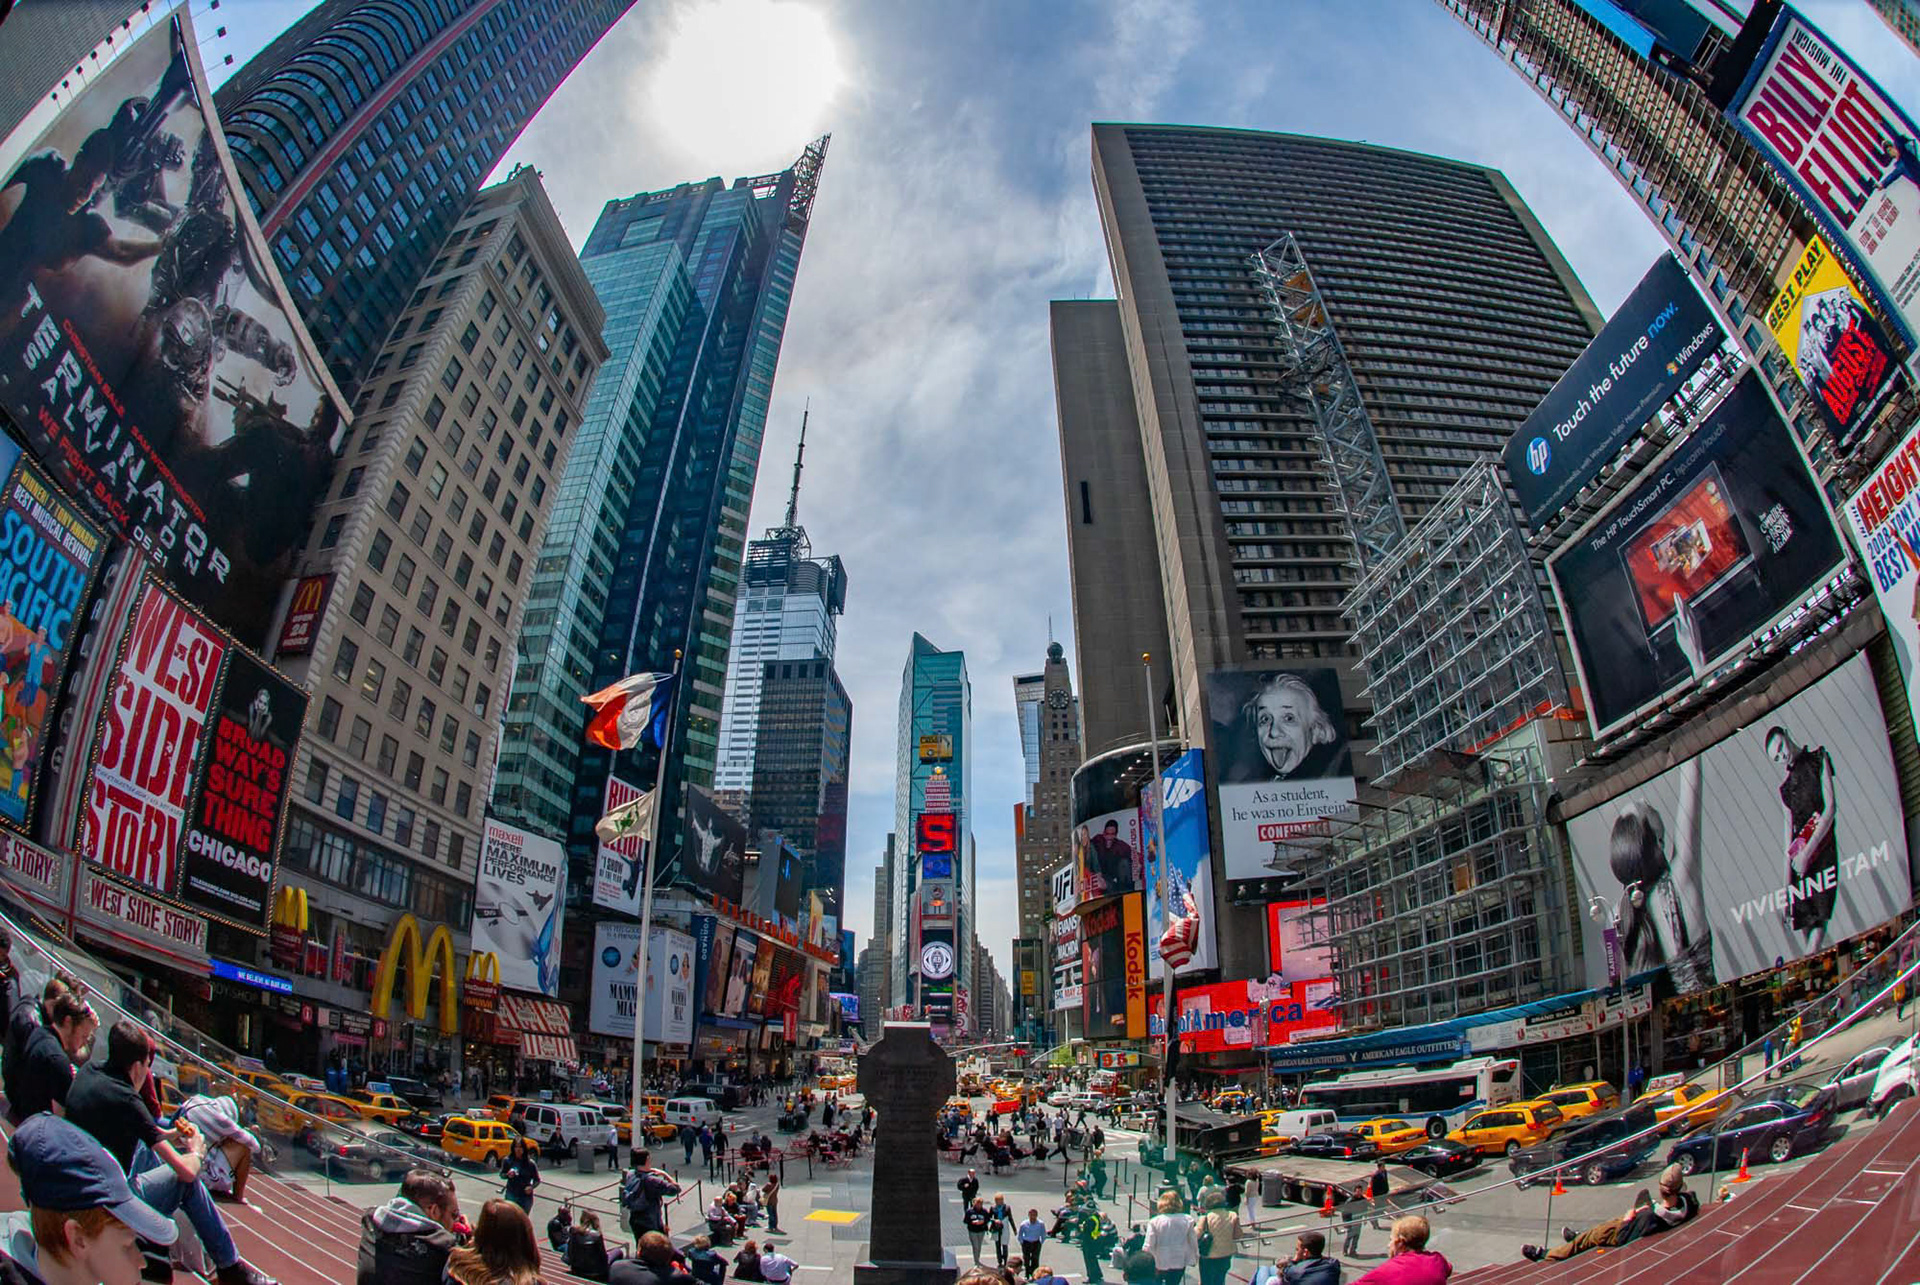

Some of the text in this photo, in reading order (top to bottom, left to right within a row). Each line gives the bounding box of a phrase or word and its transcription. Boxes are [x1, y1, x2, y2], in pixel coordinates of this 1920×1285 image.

[1793, 27, 1848, 86] THE MUSICAL
[1746, 40, 1837, 166] BILLY
[1797, 79, 1897, 231] ELLIOT
[1769, 241, 1822, 331] BEST PLAY
[1553, 301, 1679, 442] Touch the future now.
[1675, 323, 1714, 367] Windows
[21, 282, 231, 584] TERMINATOR
[23, 339, 200, 577] SALVATION
[38, 405, 60, 439] WE
[58, 436, 95, 482] FIGHT
[94, 479, 130, 527] BACK
[1591, 423, 1727, 551] The HP TouchSmart PC. hp.com/touch
[1856, 436, 1920, 537] HEIGHT
[13, 483, 35, 512] BEST
[31, 502, 65, 543] MUSICAL
[62, 532, 93, 568] REVIVAL
[1867, 526, 1892, 561] 2008
[1891, 501, 1916, 531] TONY
[0, 509, 87, 614] SOUTH
[1874, 541, 1910, 594] BEST
[0, 555, 72, 652] ACIFIC
[122, 583, 224, 716] WEST
[101, 672, 202, 809] SIDE
[216, 736, 281, 791] WAY'S
[219, 714, 286, 768] BROAD
[208, 763, 278, 820] SURE
[1232, 807, 1248, 821] he
[1250, 808, 1275, 820] was
[1278, 807, 1294, 818] no
[1253, 787, 1329, 804] As a student,
[83, 775, 180, 895] STORY
[203, 790, 272, 853] THING
[488, 836, 523, 853] WHERE
[489, 826, 524, 846] maxell
[13, 839, 54, 885] STORY
[188, 829, 272, 883] CHICAGO
[483, 862, 526, 886] LIVES
[484, 855, 556, 884] PERFORMANCE
[486, 844, 557, 877] MAXIMUM
[1730, 840, 1891, 925] VIVIENNE TAM
[91, 877, 127, 917] WEST
[127, 895, 162, 932] SIDE
[163, 910, 202, 945] STORY
[701, 917, 710, 961] VORNADO
[1058, 915, 1077, 937] EVANS
[1126, 931, 1144, 1000] Kodak
[1606, 942, 1616, 976] KARIBU
[1055, 989, 1064, 1000] SAT
[1064, 988, 1075, 999] MAY
[1178, 1014, 1191, 1033] of
[1192, 1002, 1303, 1031] Amerca
[1314, 1056, 1346, 1065] OUTFITTERS
[1361, 1048, 1394, 1061] AMERICAN
[1394, 1044, 1416, 1057] EAGLE
